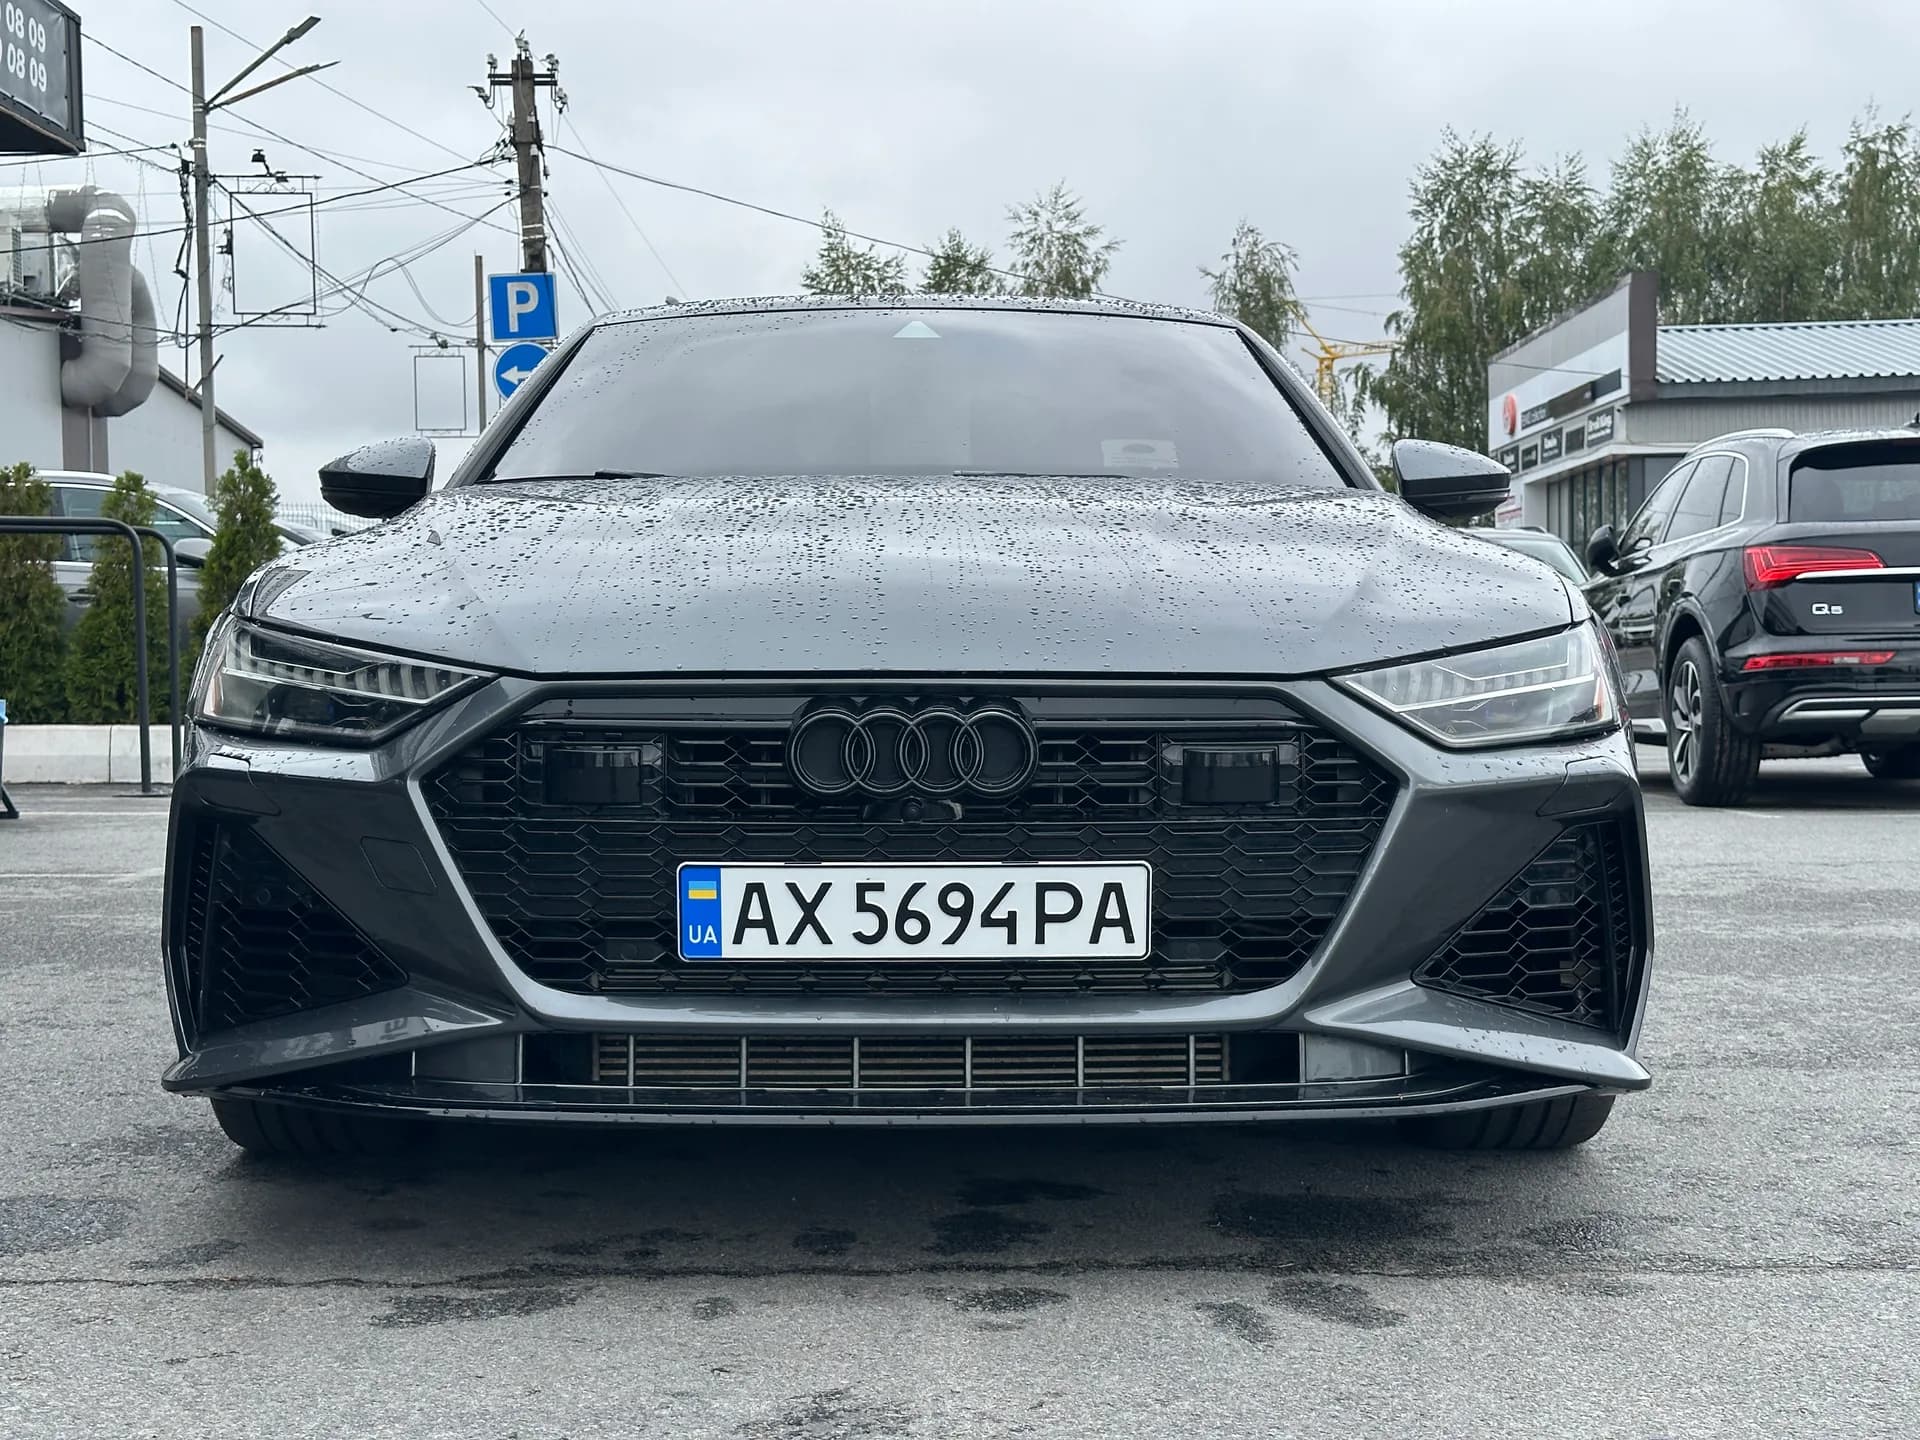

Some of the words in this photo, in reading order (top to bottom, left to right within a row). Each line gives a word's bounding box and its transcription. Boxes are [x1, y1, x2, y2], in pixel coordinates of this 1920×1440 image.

[6, 2, 25, 39] 08
[28, 17, 46, 53] 09
[7, 43, 26, 79] 08
[29, 57, 47, 92] 09
[507, 281, 539, 332] P
[1812, 603, 1843, 615] Q5
[689, 924, 718, 944] UA
[732, 881, 833, 945] AX
[852, 881, 1017, 945] 5694
[1035, 881, 1136, 945] PA
